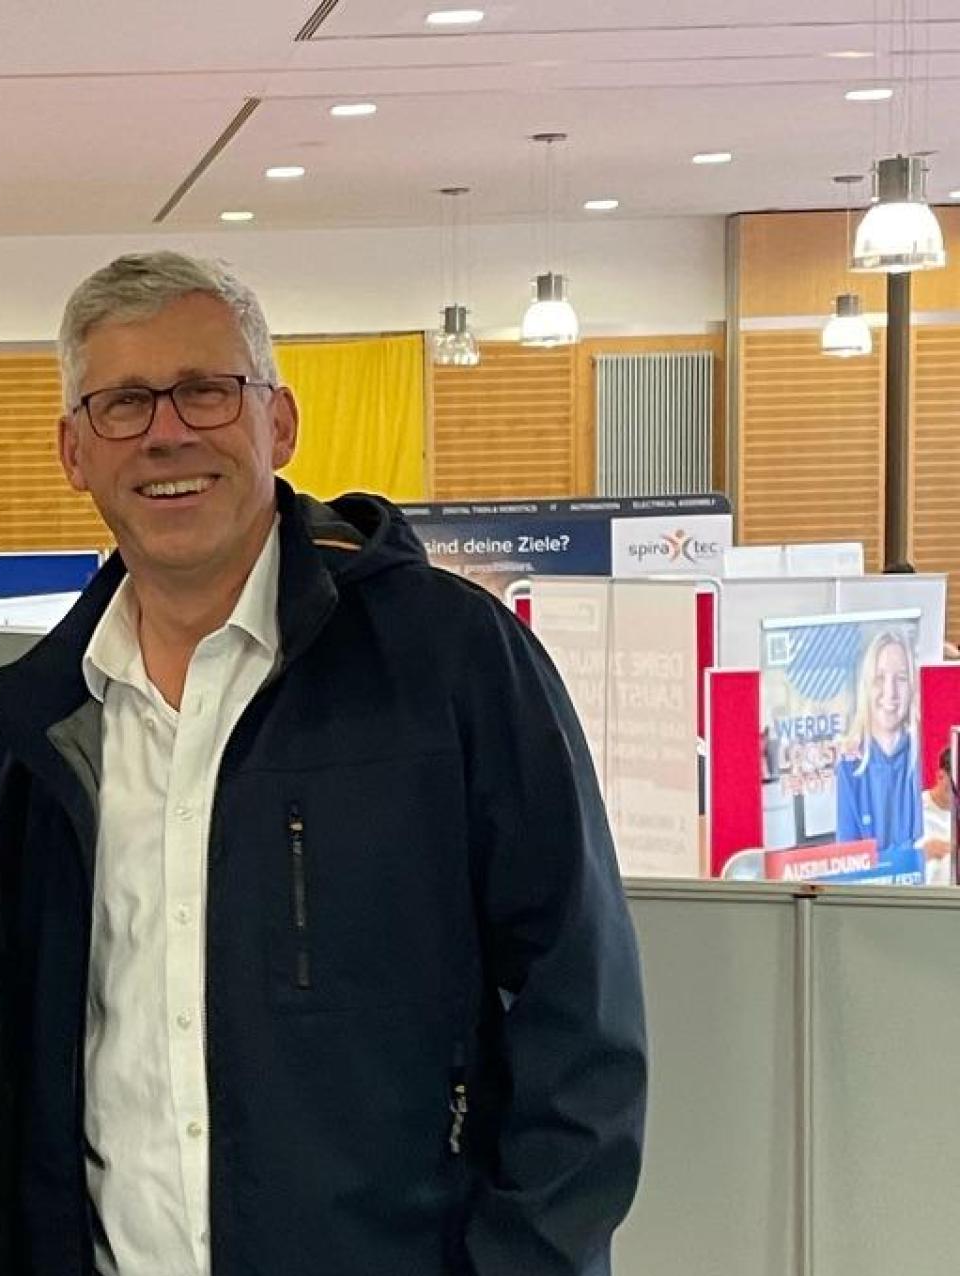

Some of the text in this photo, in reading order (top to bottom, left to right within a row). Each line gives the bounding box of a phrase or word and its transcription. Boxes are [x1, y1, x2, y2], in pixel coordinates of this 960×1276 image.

[463, 537, 513, 553] deine
[518, 534, 570, 552] Ziele?
[774, 713, 841, 738] WERDE
